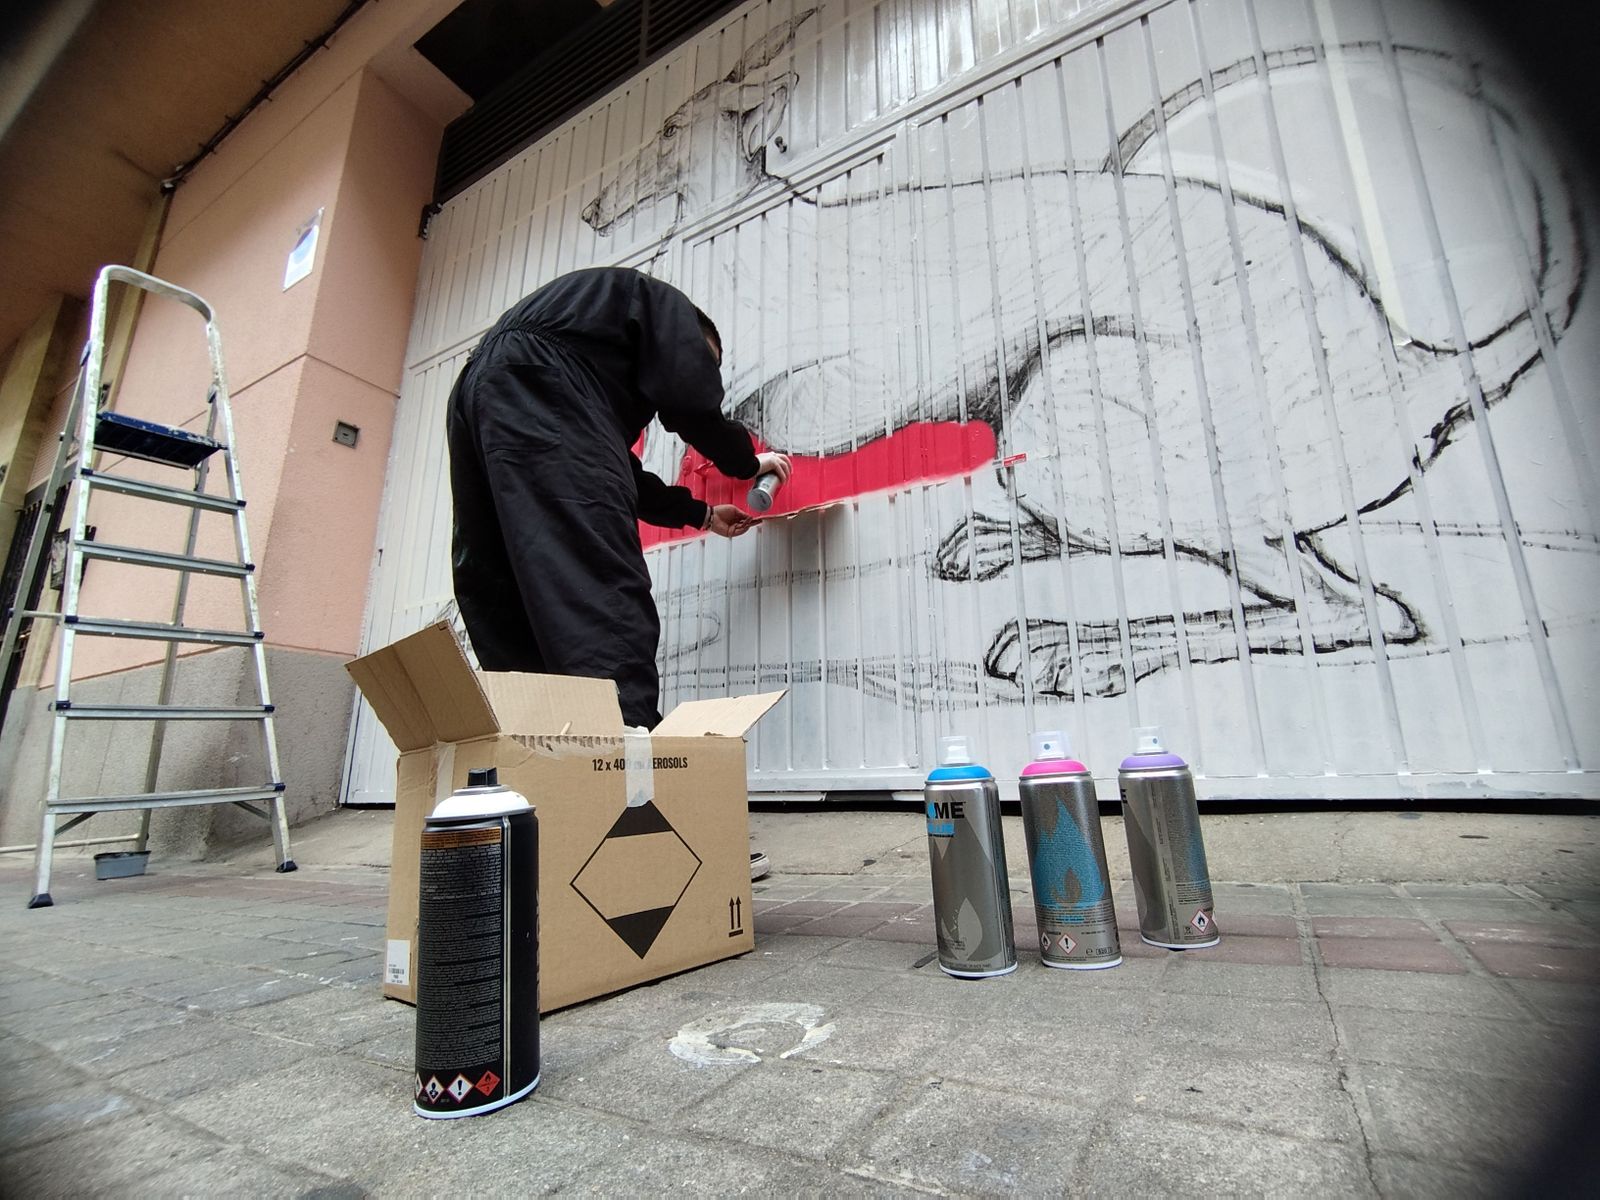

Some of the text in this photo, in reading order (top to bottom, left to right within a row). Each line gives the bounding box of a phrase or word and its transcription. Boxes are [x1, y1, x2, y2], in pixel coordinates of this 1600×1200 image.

[592, 758, 603, 771] 12
[605, 760, 612, 771] x
[613, 758, 630, 771] 40
[649, 757, 688, 770] EROSOLS
